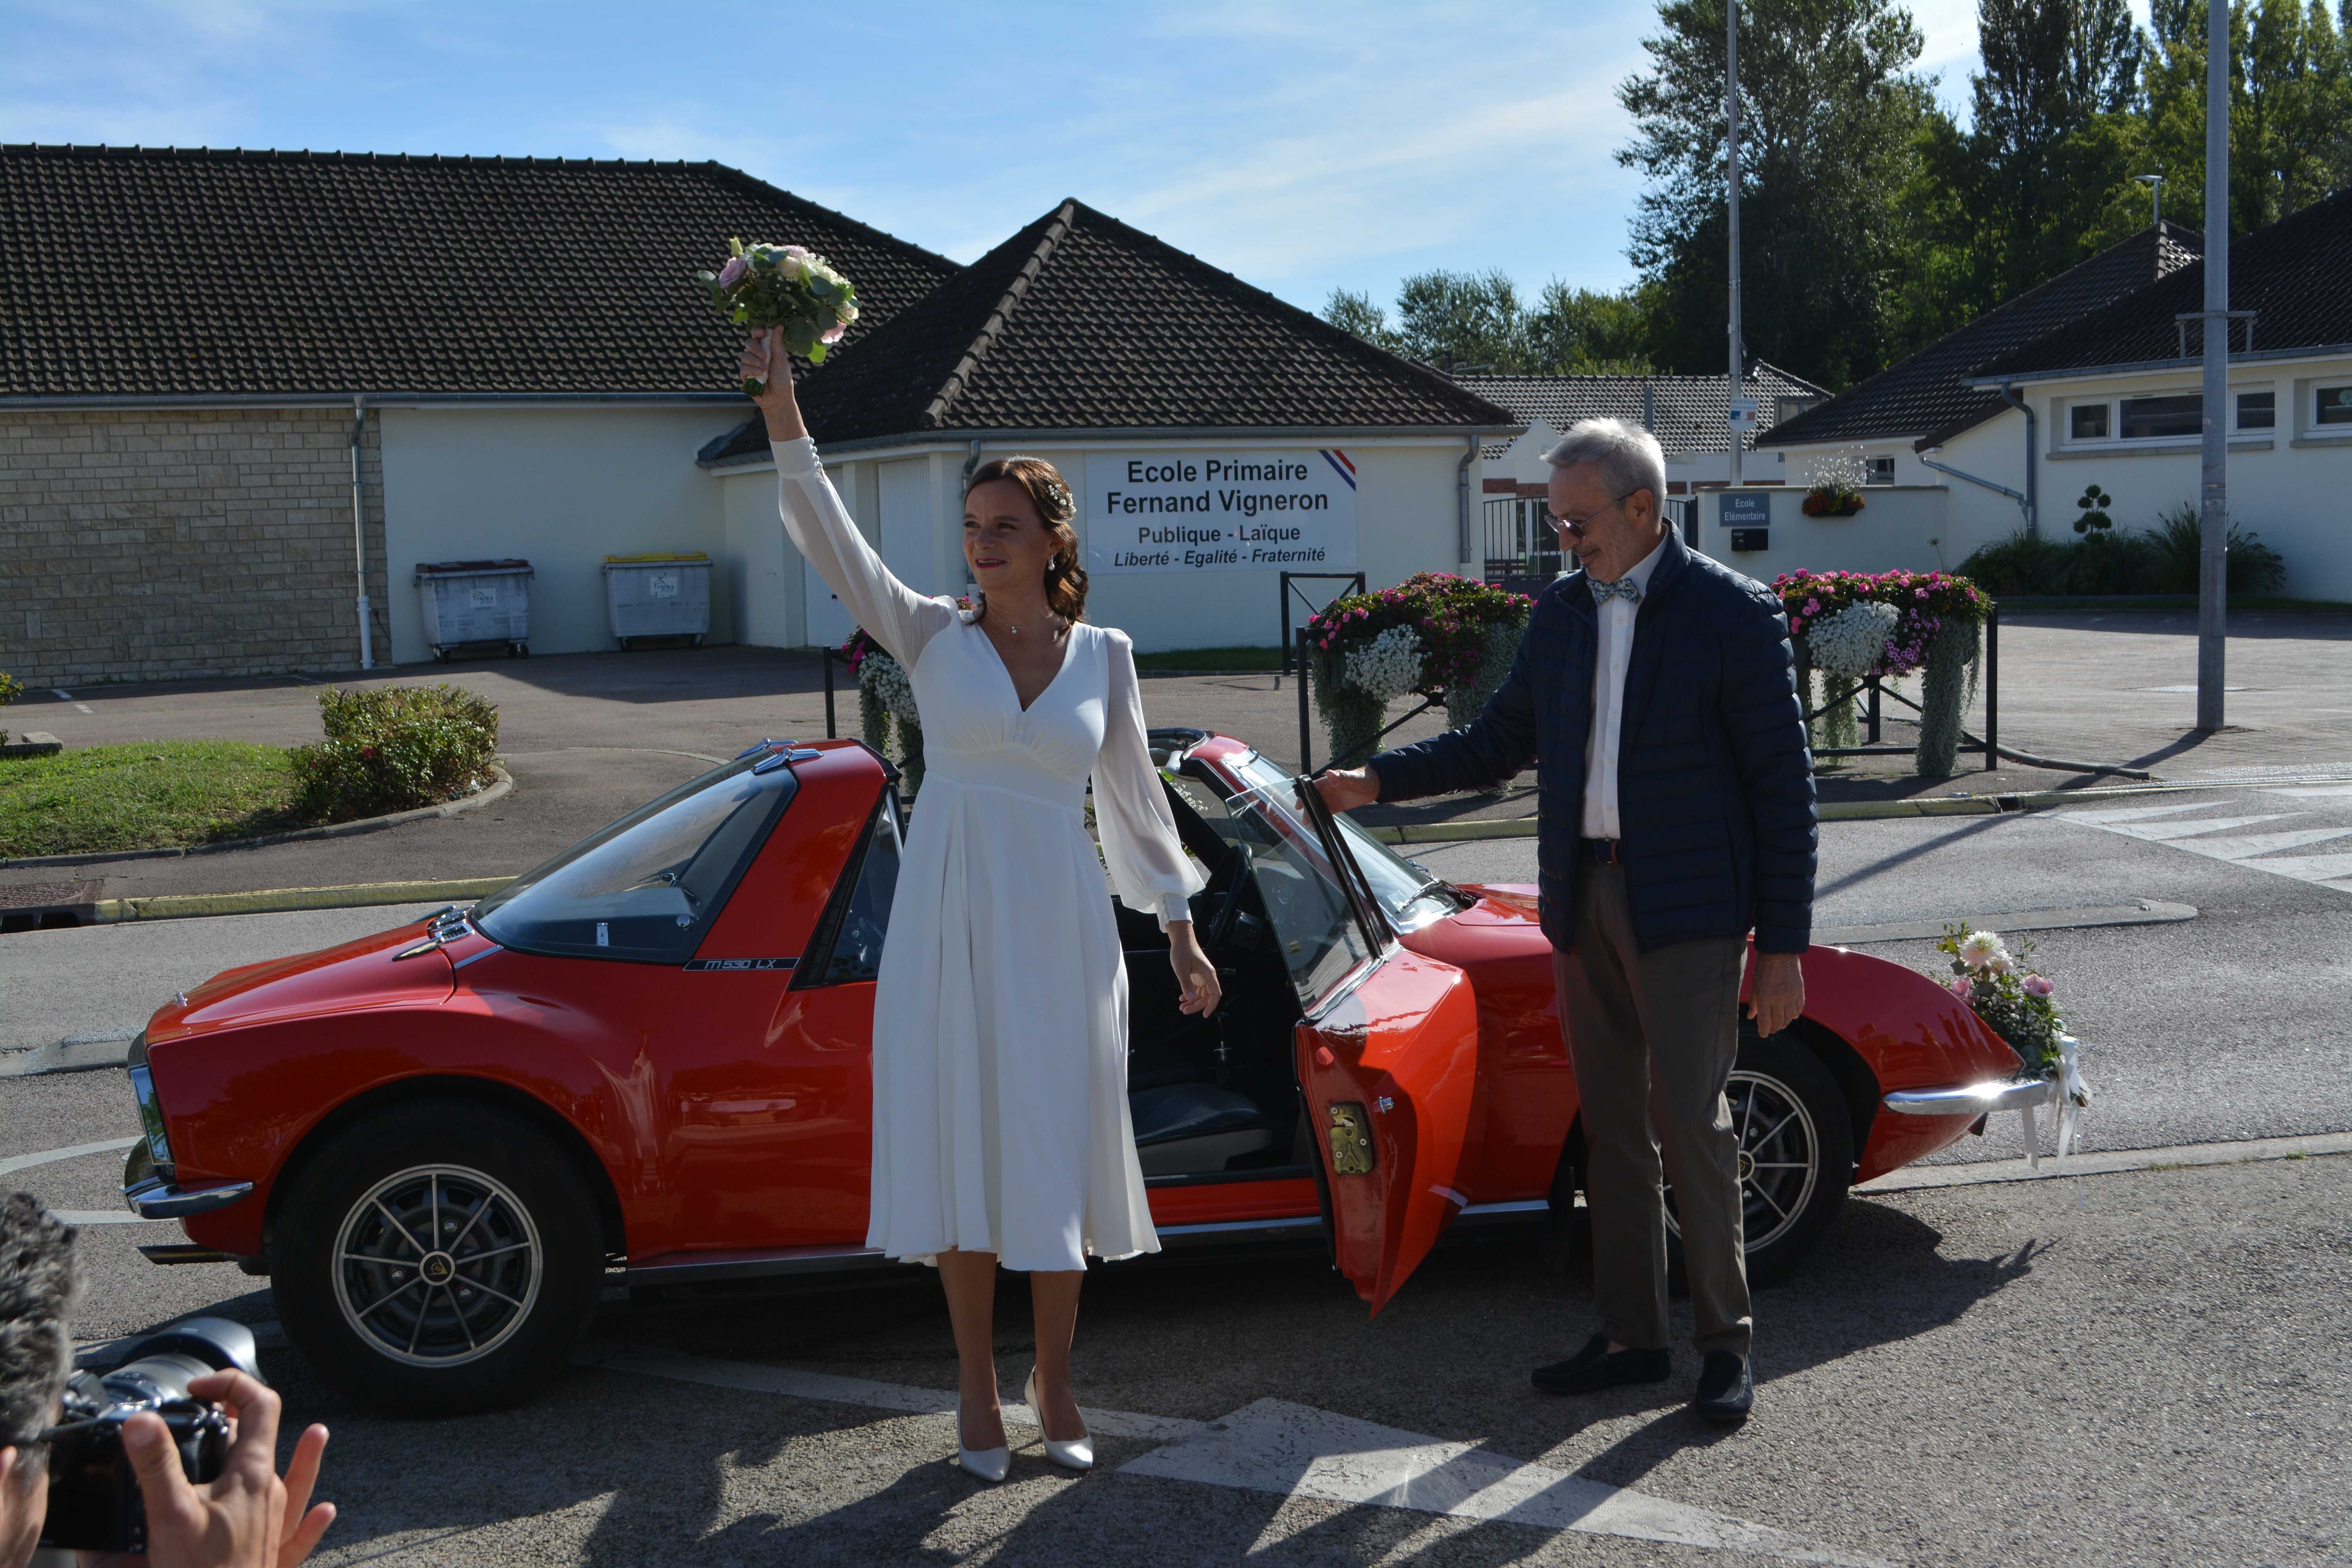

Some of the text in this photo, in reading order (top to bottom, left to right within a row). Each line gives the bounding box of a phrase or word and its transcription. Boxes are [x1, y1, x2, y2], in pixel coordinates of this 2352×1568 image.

[1128, 459, 1308, 483] Ecole Primaire
[1107, 490, 1328, 517] Fernand Vigneron
[1735, 499, 1755, 508] Ecole
[1724, 511, 1766, 521] Elémentaire
[1139, 526, 1221, 546] Publique
[1240, 524, 1300, 544] Laïque
[1114, 551, 1169, 566] Liberté
[1184, 549, 1237, 568] Egalité
[1252, 547, 1325, 563] Fraternité
[755, 959, 777, 969] LX
